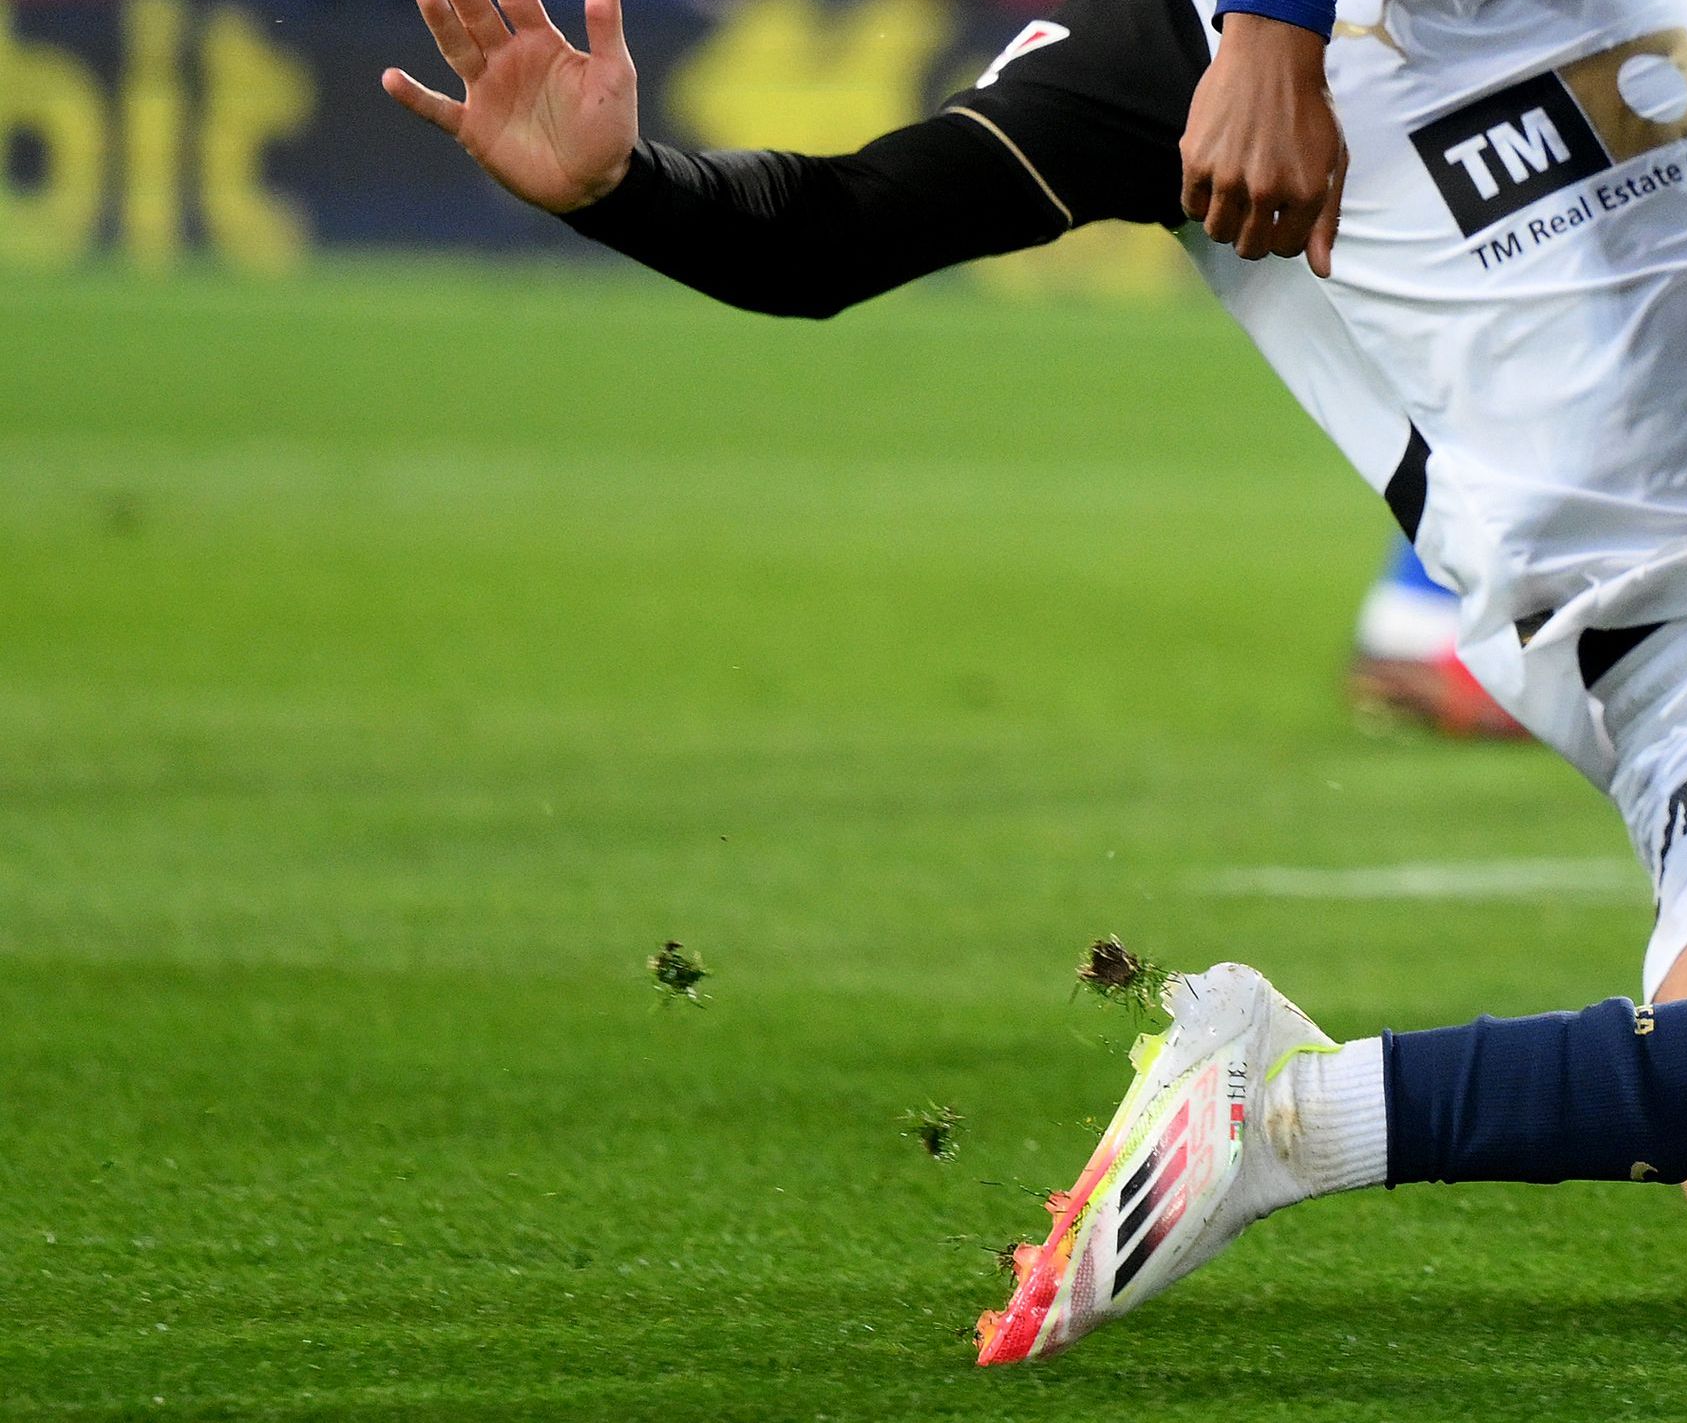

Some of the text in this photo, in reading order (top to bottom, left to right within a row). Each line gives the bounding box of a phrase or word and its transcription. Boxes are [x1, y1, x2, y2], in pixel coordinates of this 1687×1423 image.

[1444, 107, 1571, 202] TM
[1470, 231, 1522, 271] TM
[1528, 196, 1593, 245] Real
[1596, 164, 1684, 212] Estate
